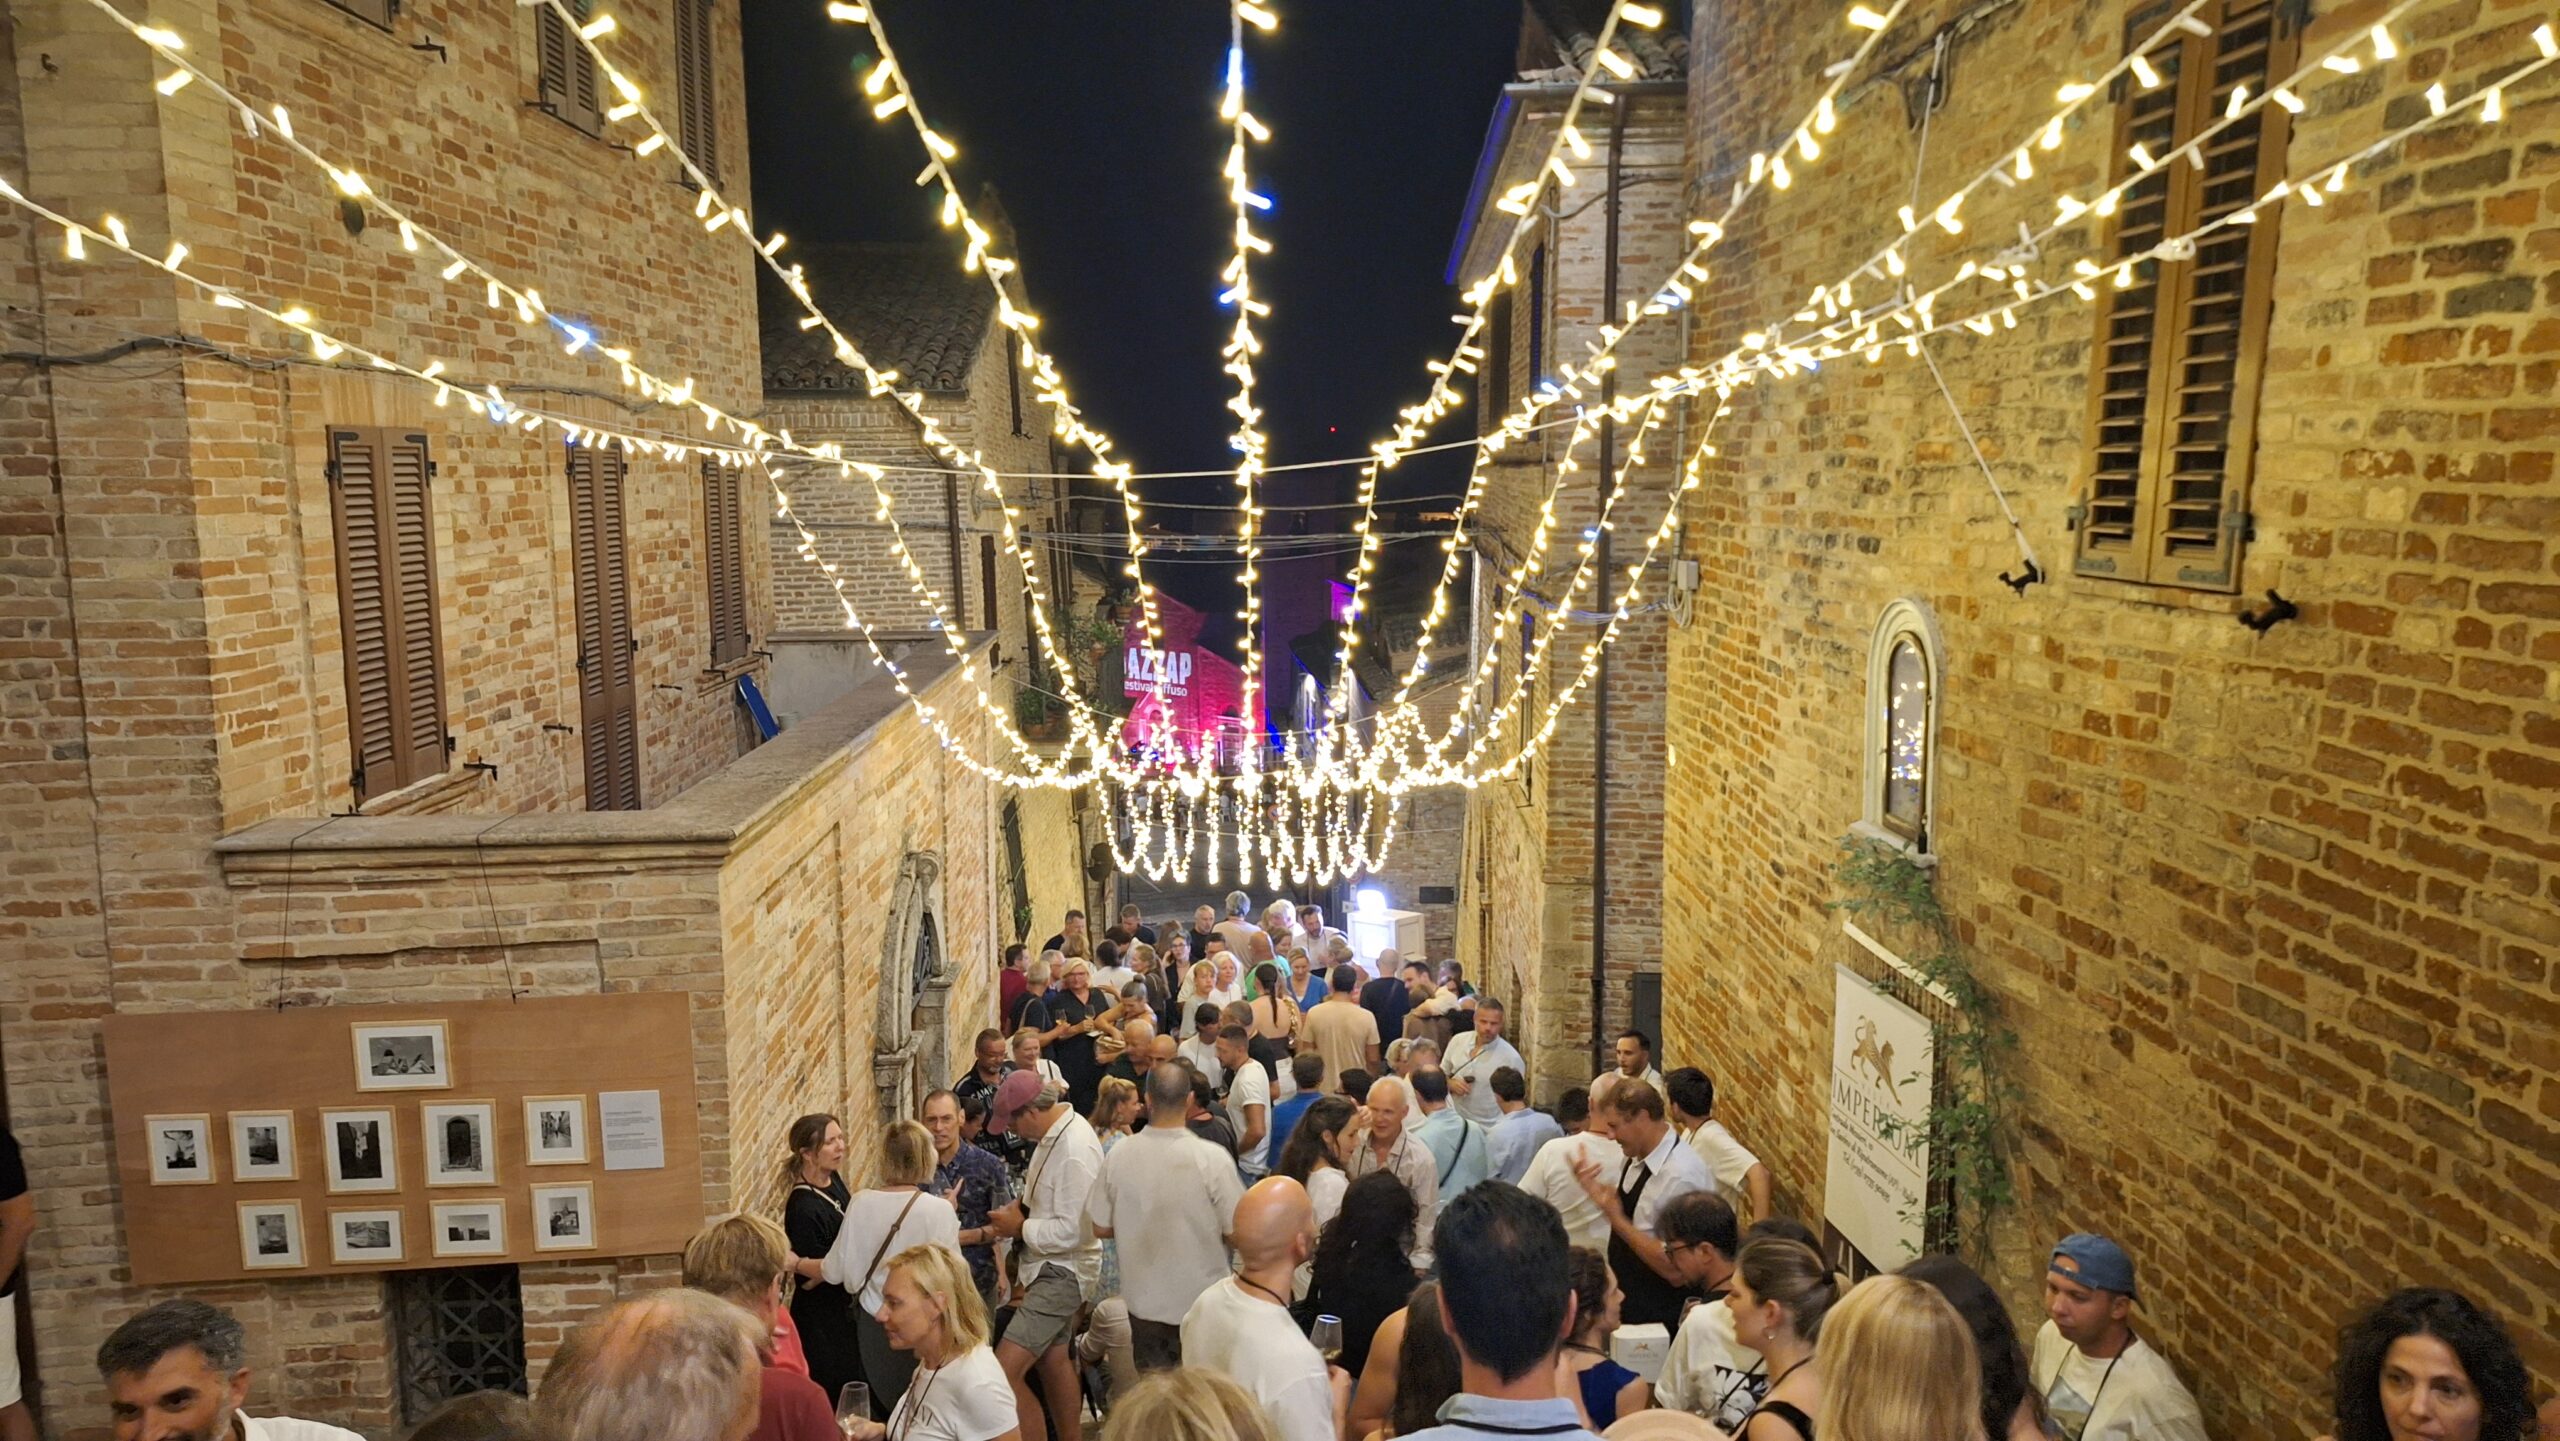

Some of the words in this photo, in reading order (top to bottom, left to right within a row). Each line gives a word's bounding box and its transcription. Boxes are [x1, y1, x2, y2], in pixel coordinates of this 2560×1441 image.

[1124, 648, 1191, 685] AZZAP
[1124, 681, 1154, 692] estival
[1832, 1072, 1920, 1169] IMPERUM
